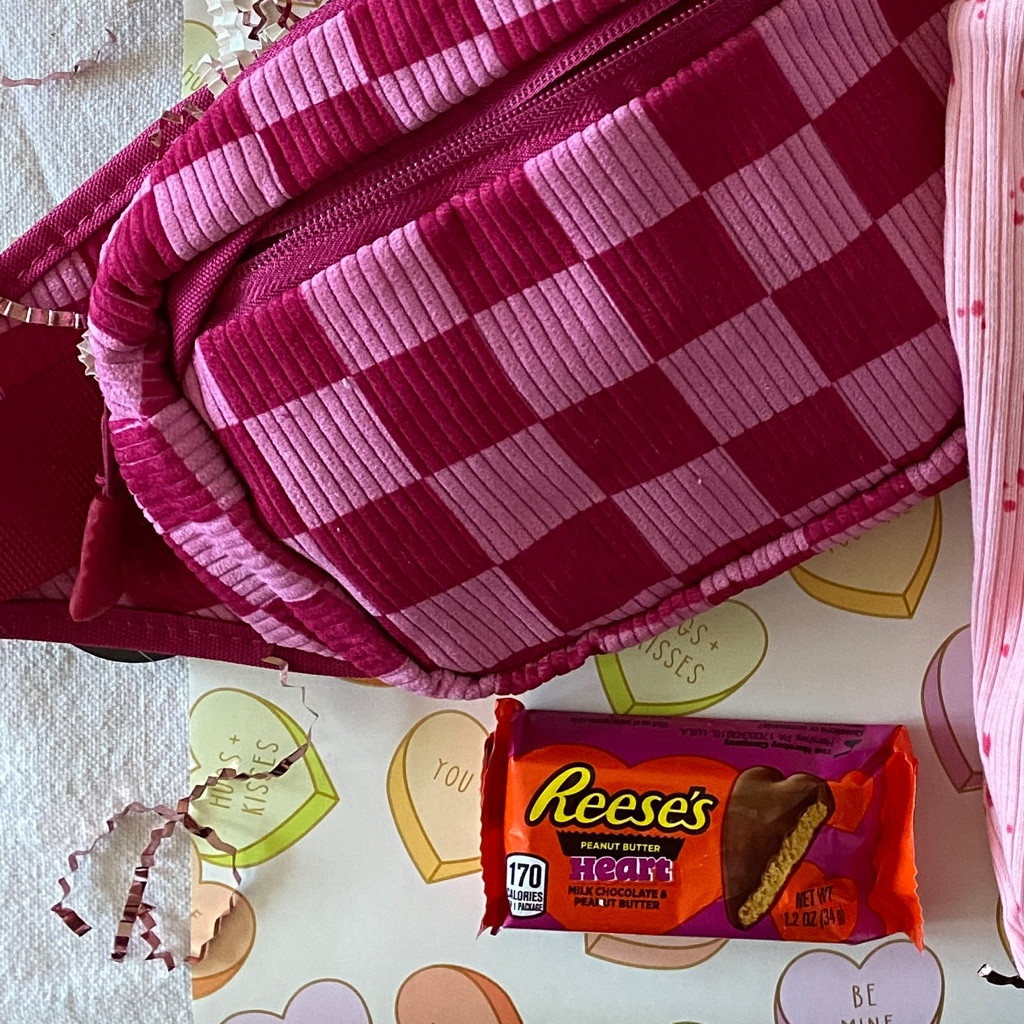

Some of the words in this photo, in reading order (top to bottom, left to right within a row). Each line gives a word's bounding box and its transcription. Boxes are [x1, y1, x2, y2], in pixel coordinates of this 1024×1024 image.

[638, 637, 705, 684] ISSES
[209, 751, 242, 809] HUS
[433, 758, 474, 794] YOU
[528, 765, 714, 830] Reese's
[580, 841, 620, 852] PEANUT
[622, 843, 661, 853] BUTTER
[509, 861, 542, 888] 170
[569, 855, 673, 883] Heart
[568, 885, 593, 896] MILK
[595, 887, 659, 899] CHOCOLATE
[618, 899, 660, 910] BUTTER
[796, 889, 816, 908] NET
[816, 885, 834, 903] WT
[784, 912, 799, 926] 1.2
[802, 910, 818, 927] OZ
[852, 983, 877, 1007] BE
